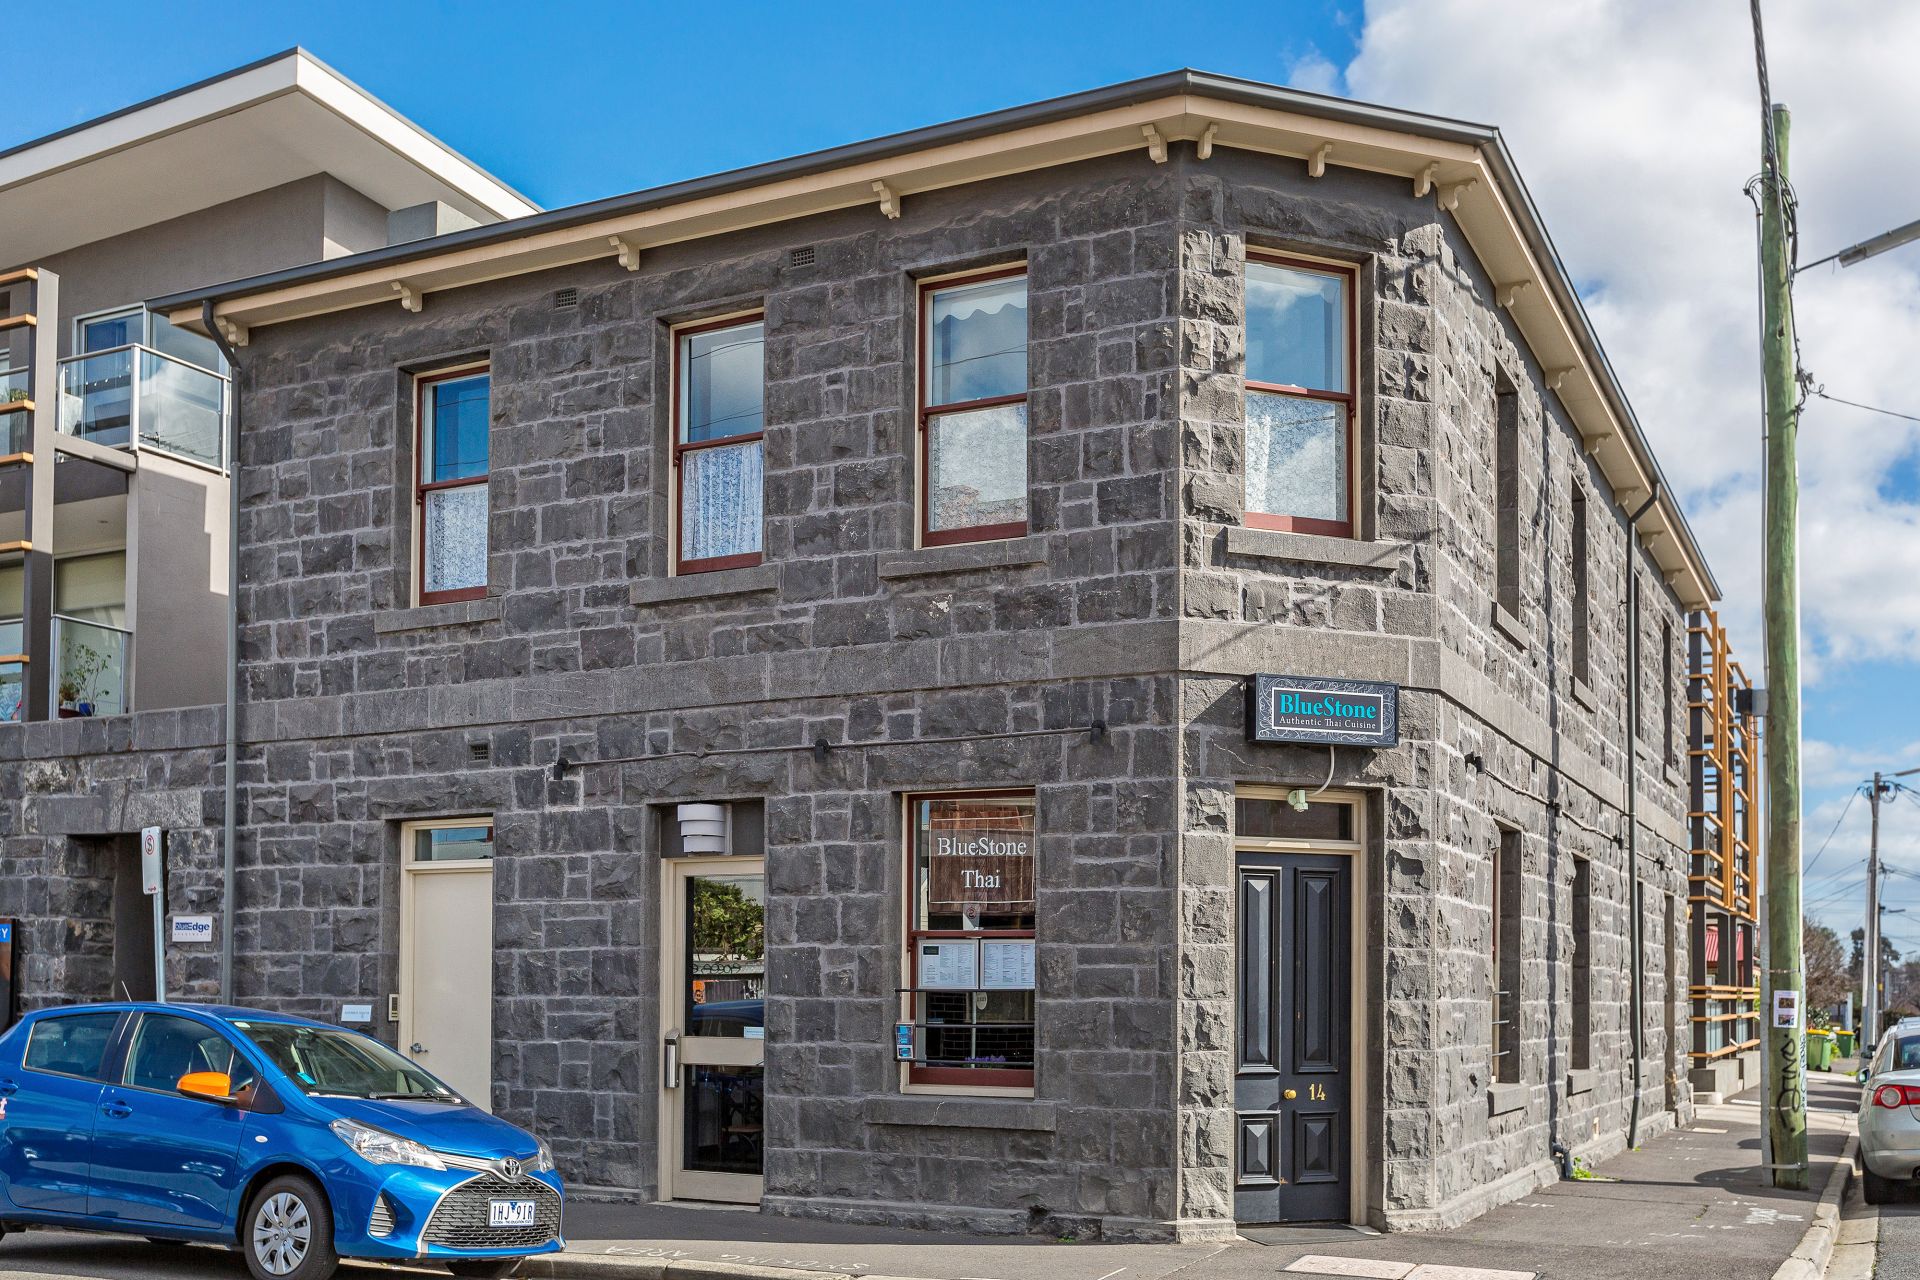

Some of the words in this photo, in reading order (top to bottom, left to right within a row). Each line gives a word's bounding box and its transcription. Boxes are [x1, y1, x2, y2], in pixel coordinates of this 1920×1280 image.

[1280, 694, 1376, 718] BlueStone
[1280, 716, 1322, 726] Authentic
[1325, 718, 1342, 727] Thai
[1345, 719, 1376, 729] Cuisine
[937, 837, 1027, 856] BlueStone
[961, 869, 1001, 888] Thai
[1309, 1083, 1326, 1101] 14
